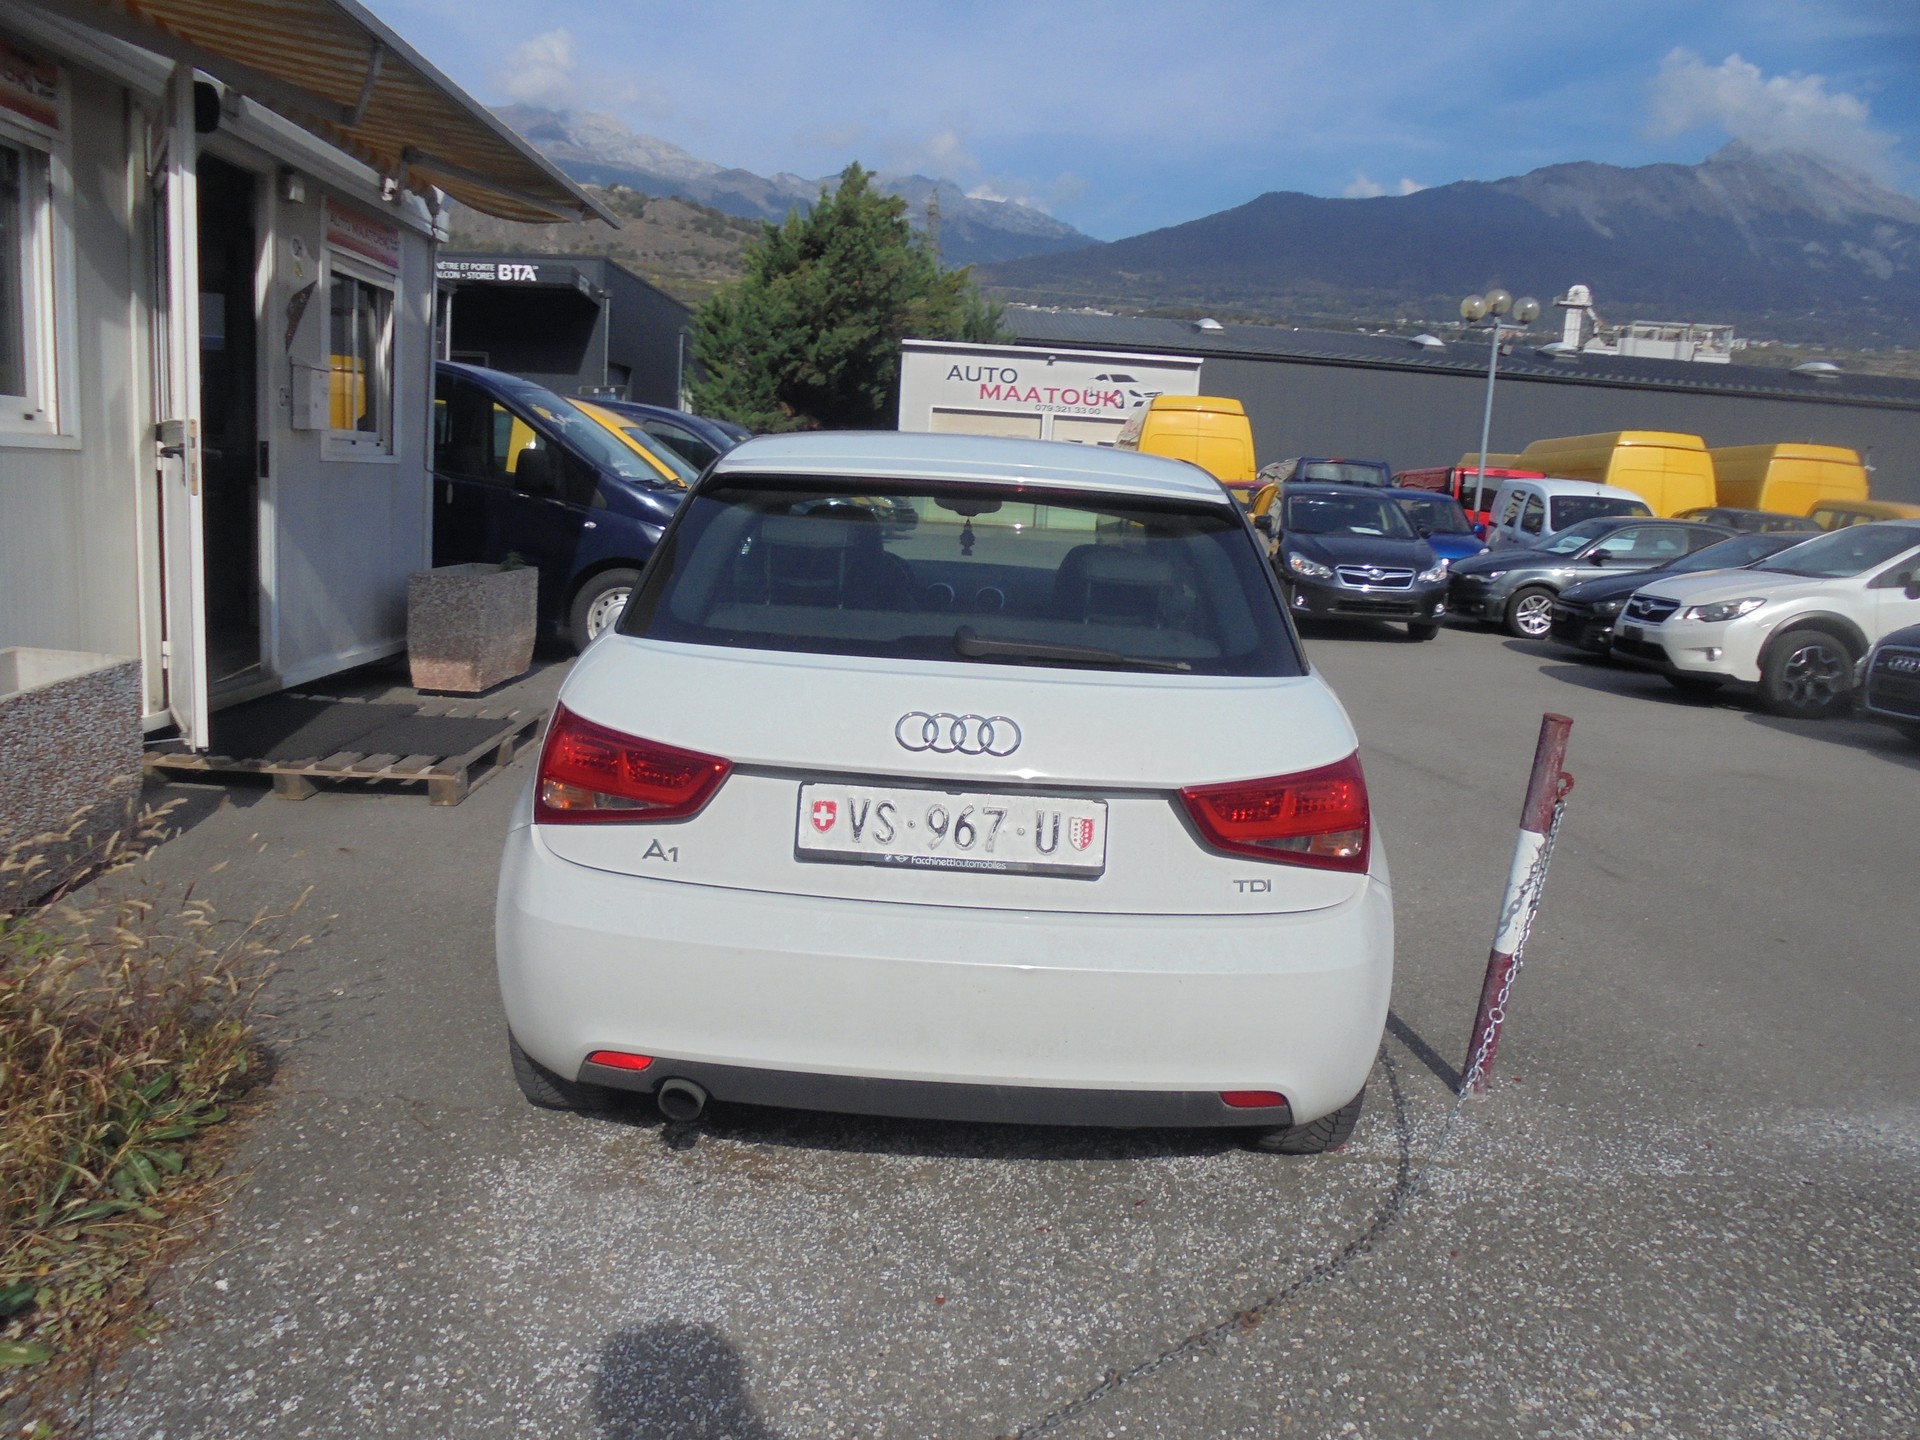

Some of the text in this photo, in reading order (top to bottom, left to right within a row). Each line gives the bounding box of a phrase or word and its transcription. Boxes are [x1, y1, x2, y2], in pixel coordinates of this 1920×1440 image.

[470, 263, 496, 271] PORTE
[498, 264, 537, 281] BTA
[467, 271, 496, 280] STORES
[946, 365, 1018, 384] AUTO
[979, 383, 1121, 409] MAATOUK
[1035, 404, 1053, 412] 079
[1054, 405, 1071, 413] 321
[642, 838, 679, 863] A1
[1233, 879, 1272, 893] TDI
